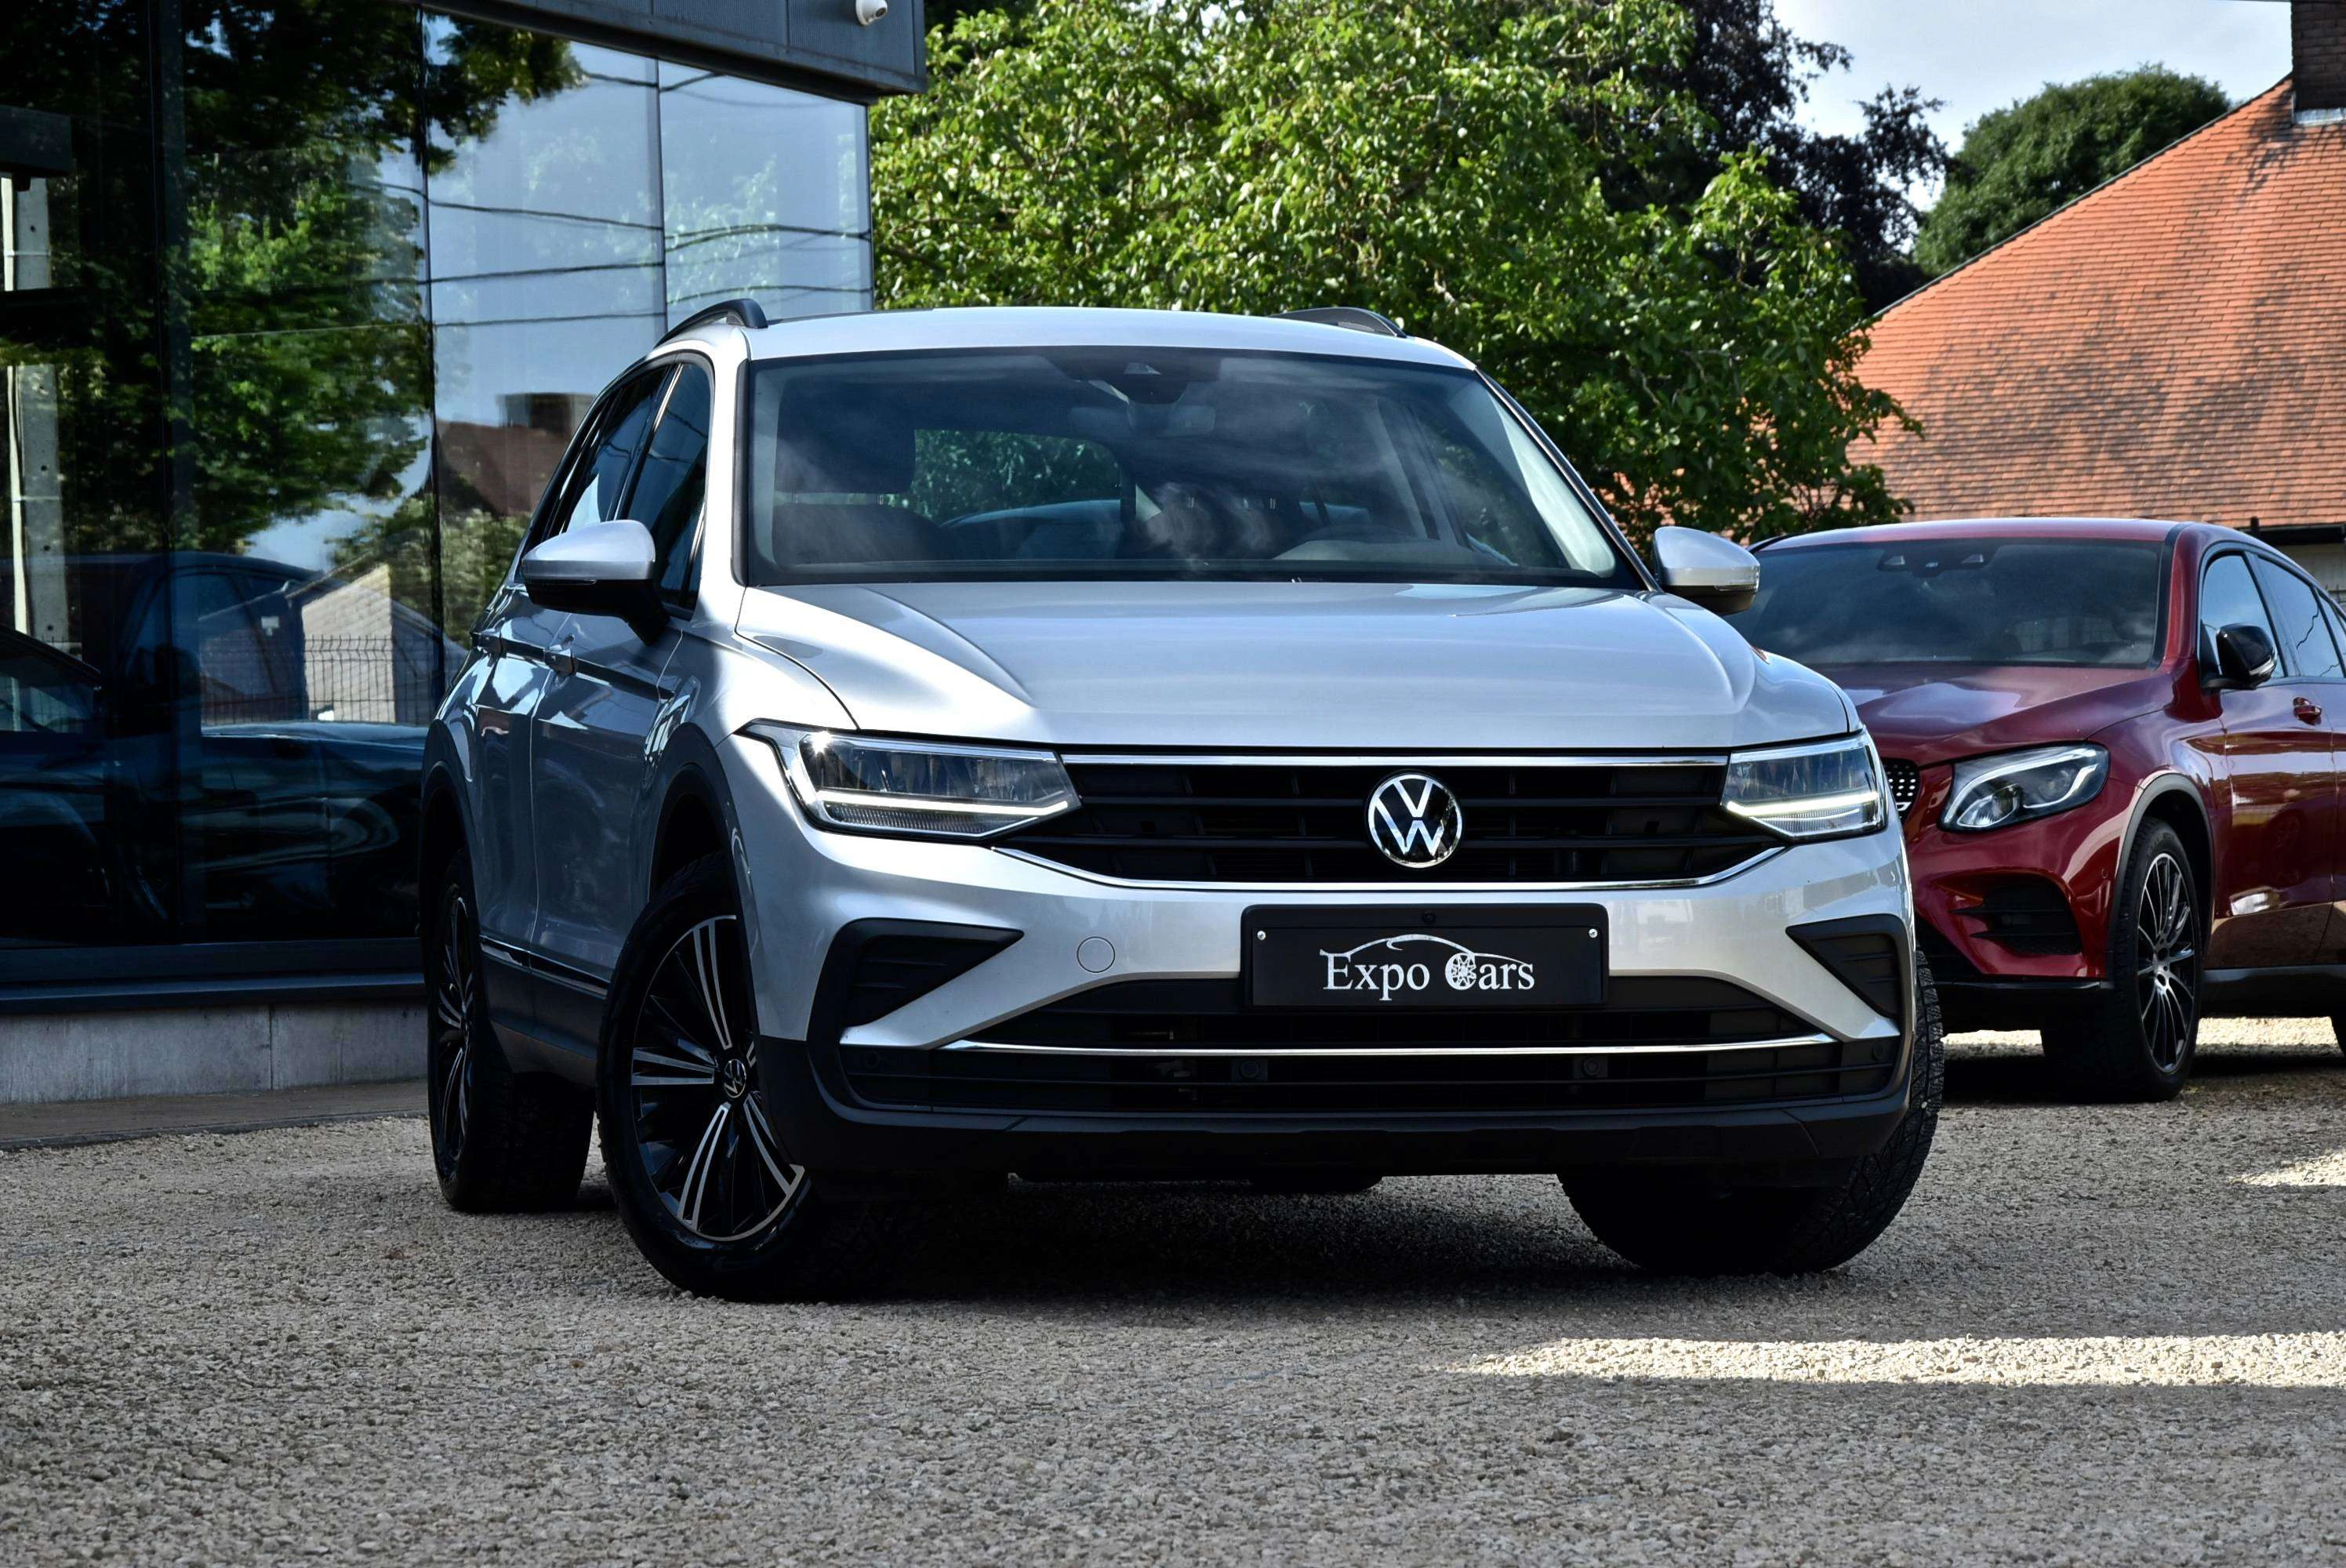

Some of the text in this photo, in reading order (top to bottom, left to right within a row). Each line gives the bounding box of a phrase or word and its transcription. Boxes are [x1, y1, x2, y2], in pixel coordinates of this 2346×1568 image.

[1369, 775, 1462, 867] VW
[1320, 949, 1534, 1000] Expo Cars
